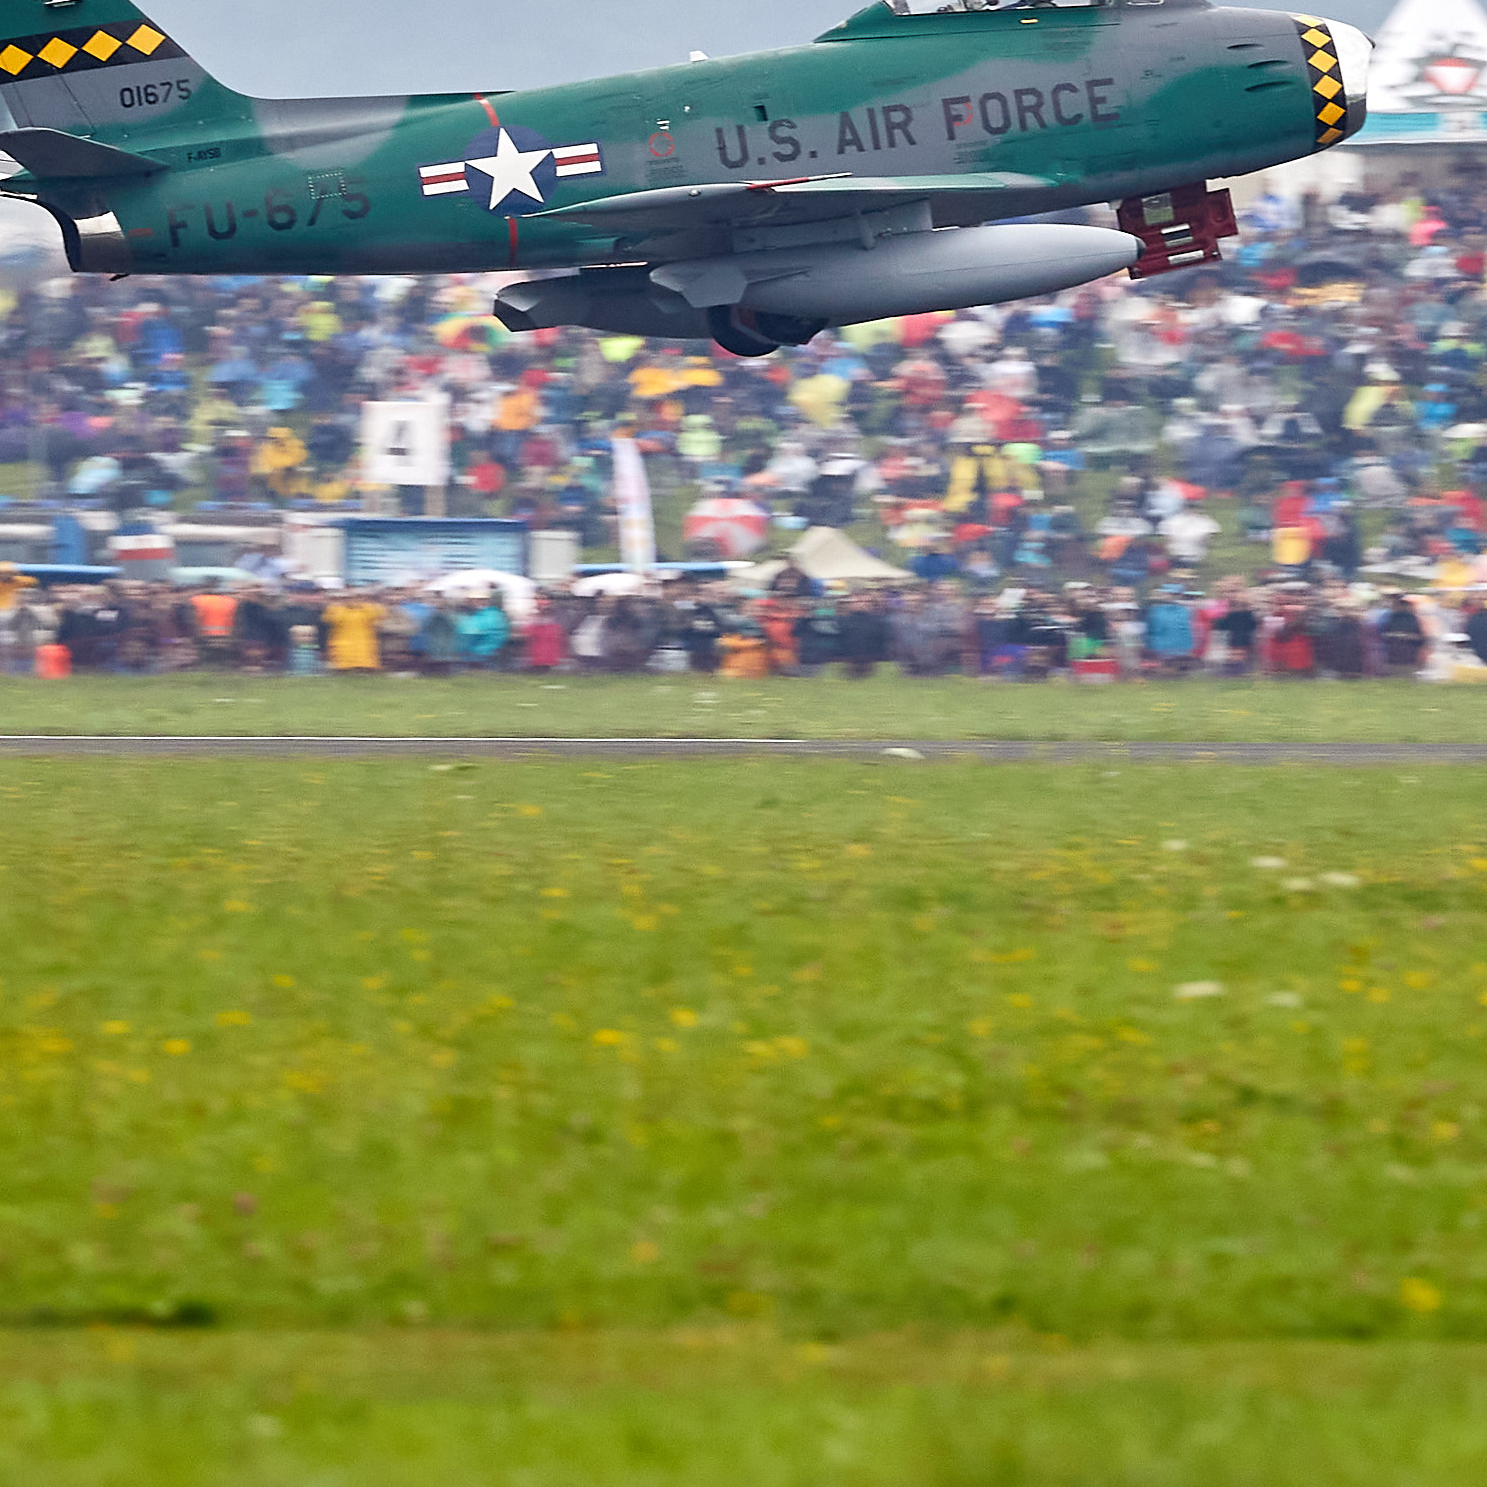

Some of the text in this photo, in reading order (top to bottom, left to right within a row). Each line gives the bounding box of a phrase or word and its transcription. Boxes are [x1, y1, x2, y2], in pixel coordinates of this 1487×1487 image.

[119, 79, 191, 109] 01675
[715, 118, 818, 169] U.S.
[837, 104, 917, 155] AIR
[941, 78, 1121, 141] FORCE
